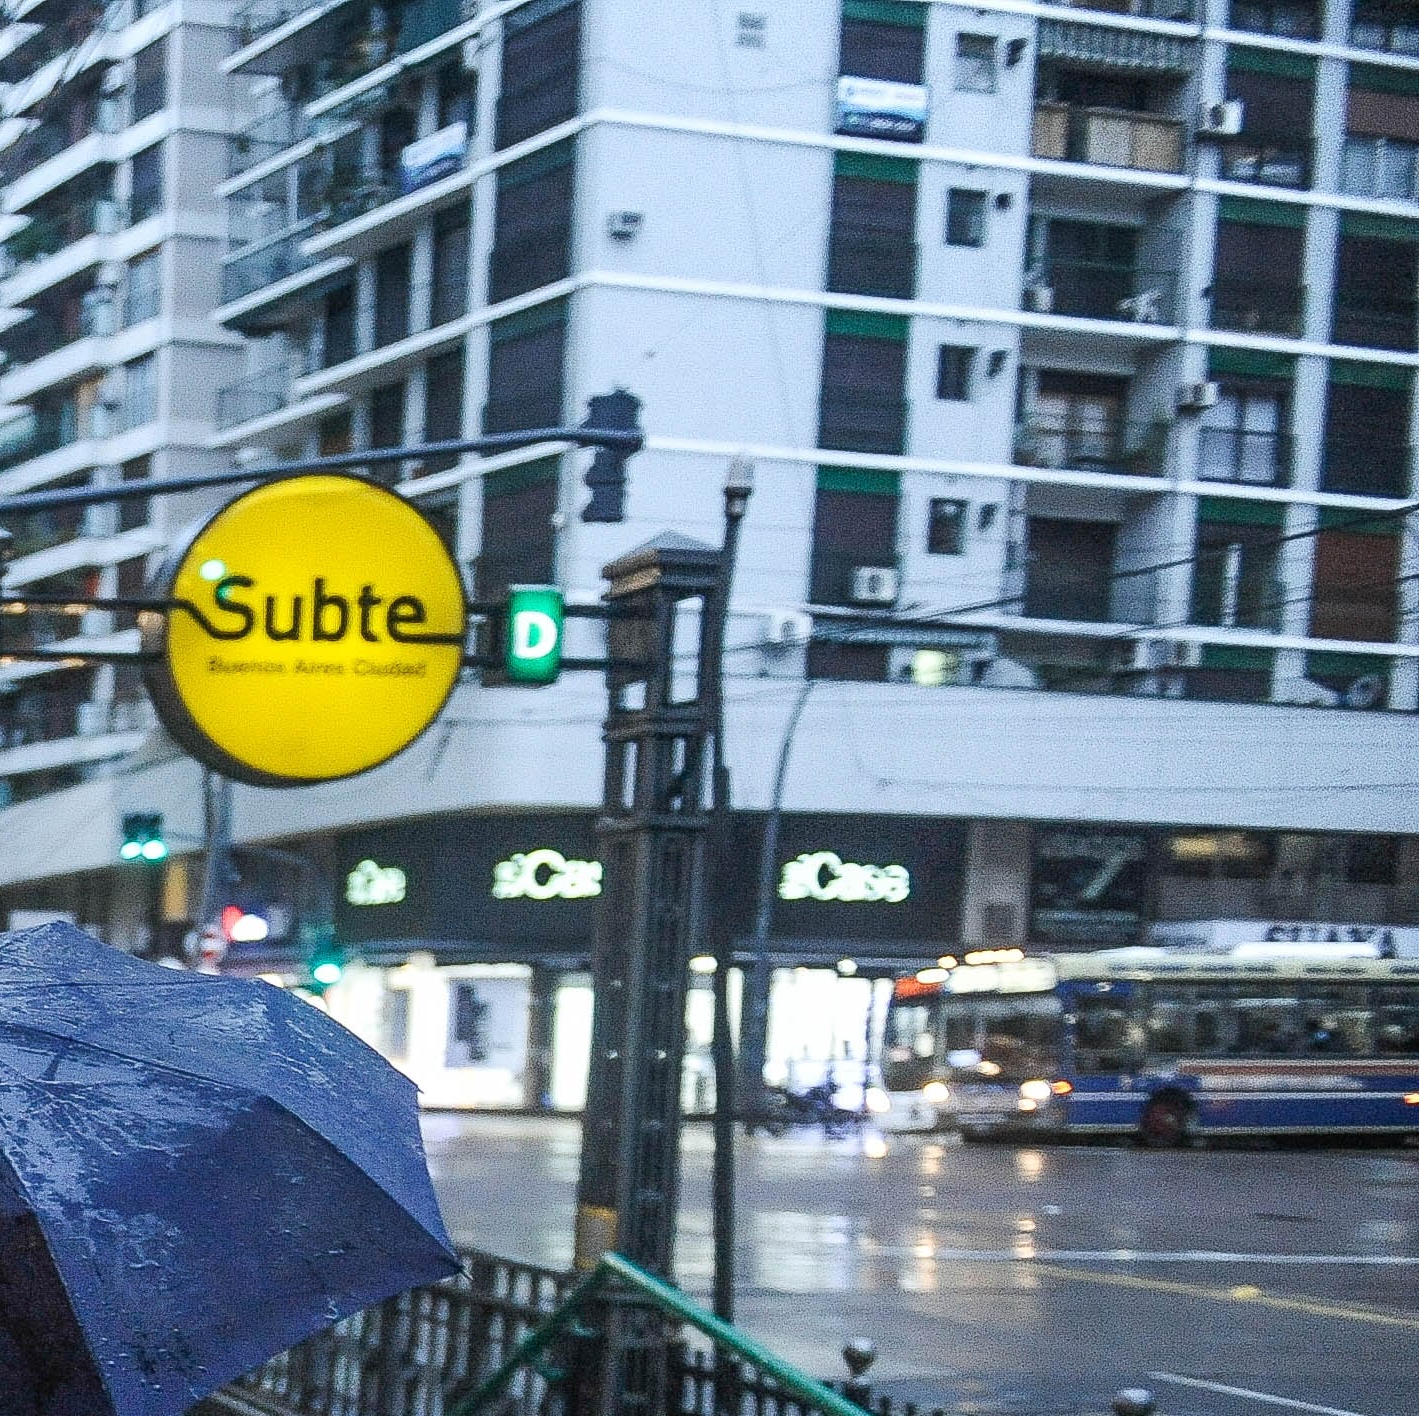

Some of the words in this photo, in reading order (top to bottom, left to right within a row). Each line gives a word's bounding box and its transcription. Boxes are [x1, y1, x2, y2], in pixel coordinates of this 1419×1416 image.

[203, 575, 429, 643] Subte
[514, 610, 557, 660] D
[208, 656, 285, 676] Buenos
[294, 657, 345, 677] Aires
[353, 658, 427, 678] Ciudad
